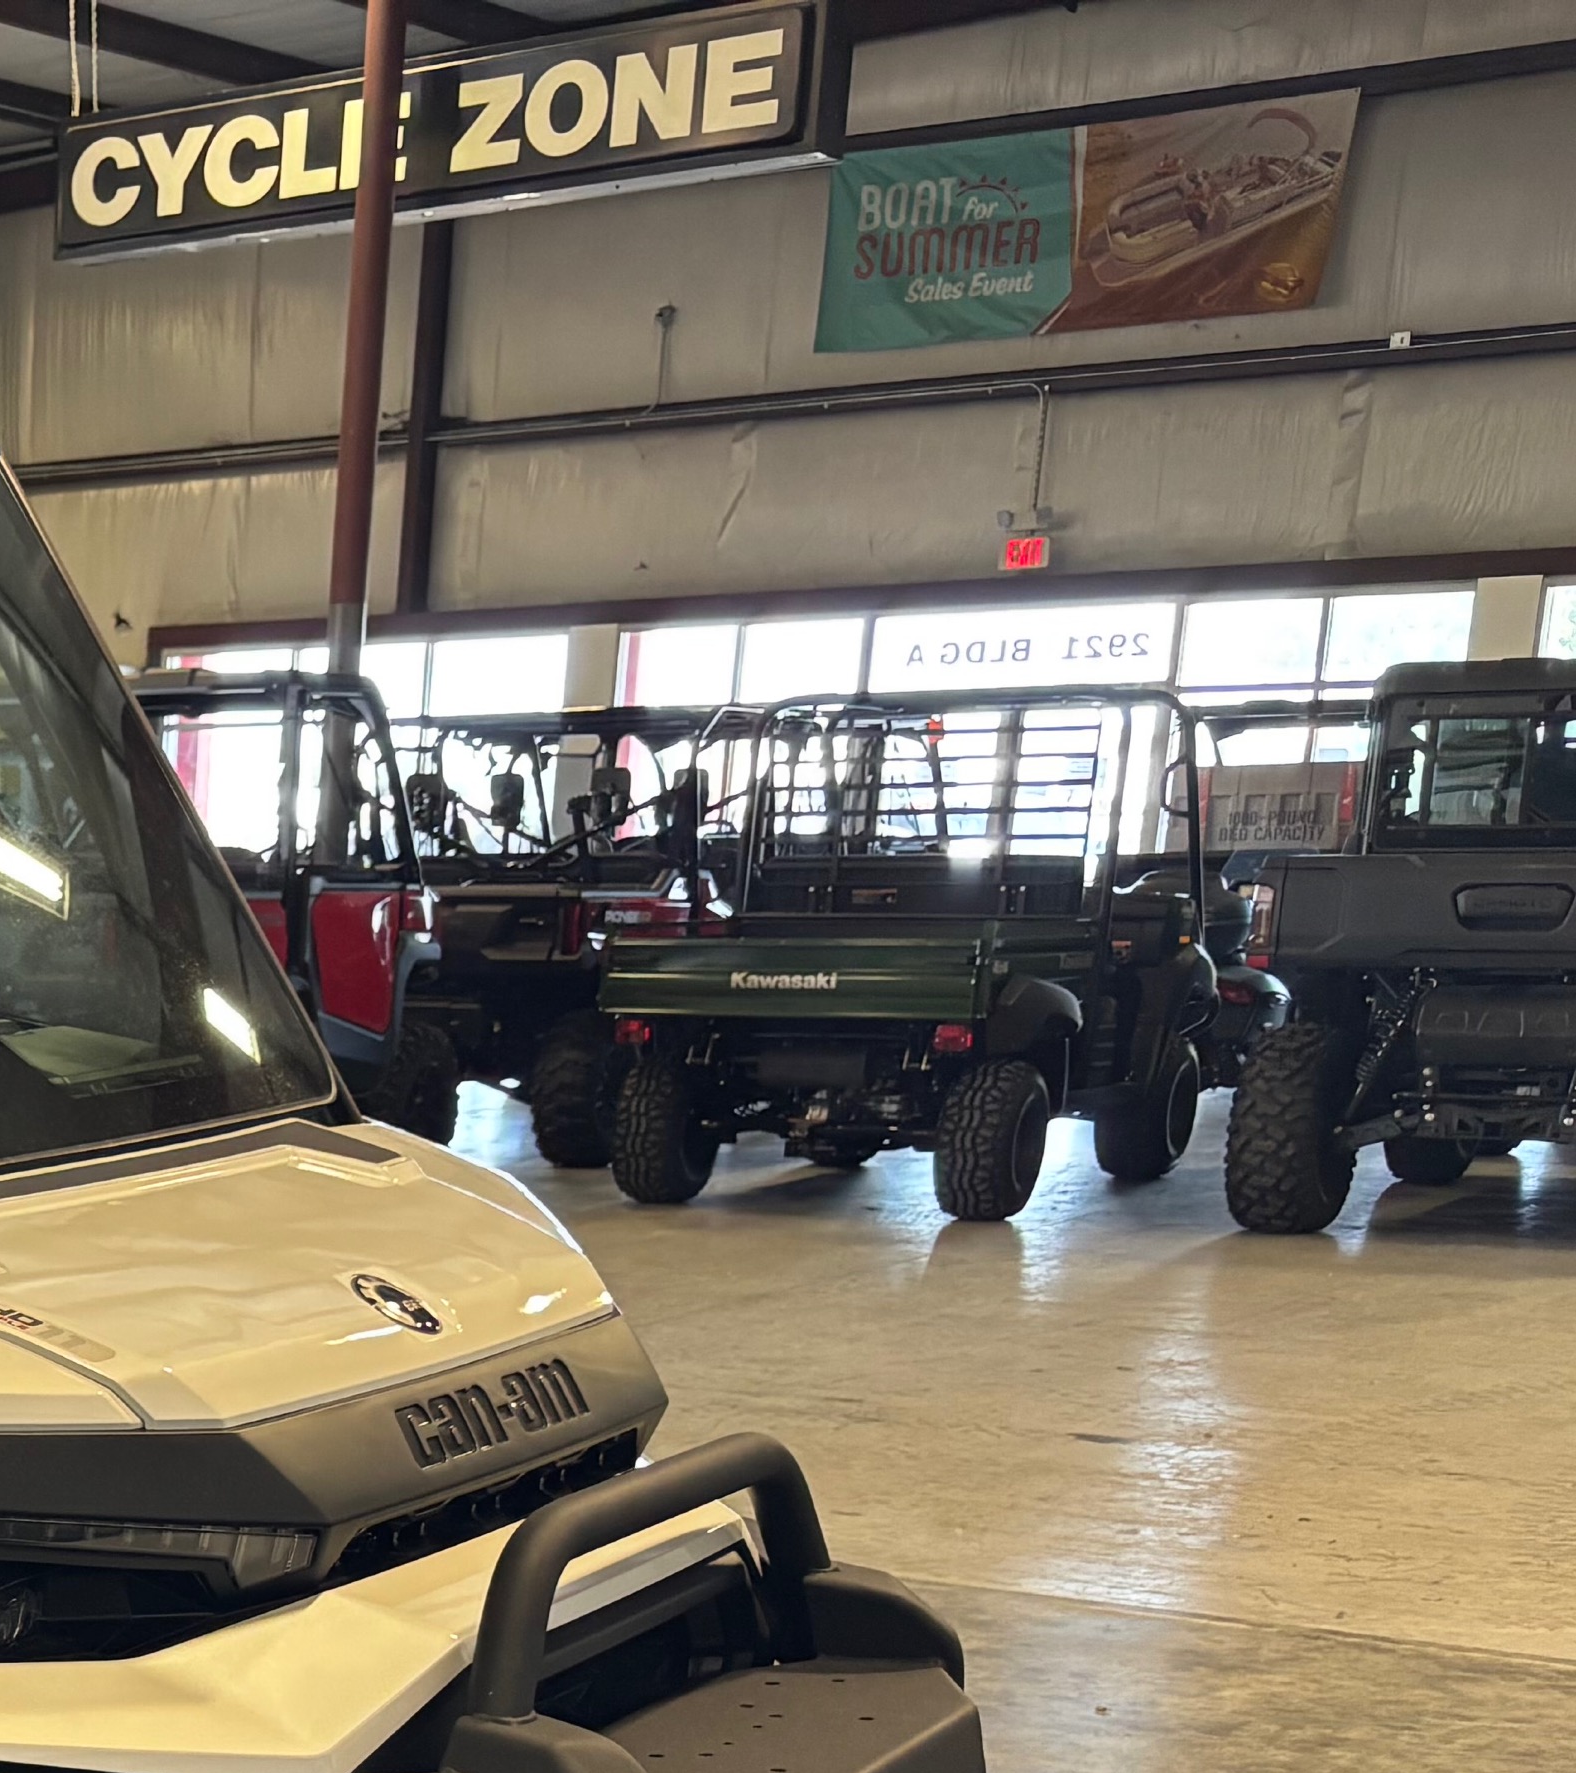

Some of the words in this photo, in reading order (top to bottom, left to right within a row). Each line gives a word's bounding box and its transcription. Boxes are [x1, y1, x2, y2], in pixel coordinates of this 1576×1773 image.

[71, 91, 411, 228] CYCLE
[450, 27, 785, 174] ZONE
[857, 176, 958, 231] BOAT
[962, 197, 999, 221] for
[853, 218, 1041, 280] SUMMER
[904, 276, 964, 303] Sales
[967, 271, 1034, 298] Event
[1005, 537, 1045, 571] EXIT
[1253, 825, 1326, 842] CAPACITY
[730, 971, 838, 989] Kawasaki
[394, 1358, 591, 1470] can-am
